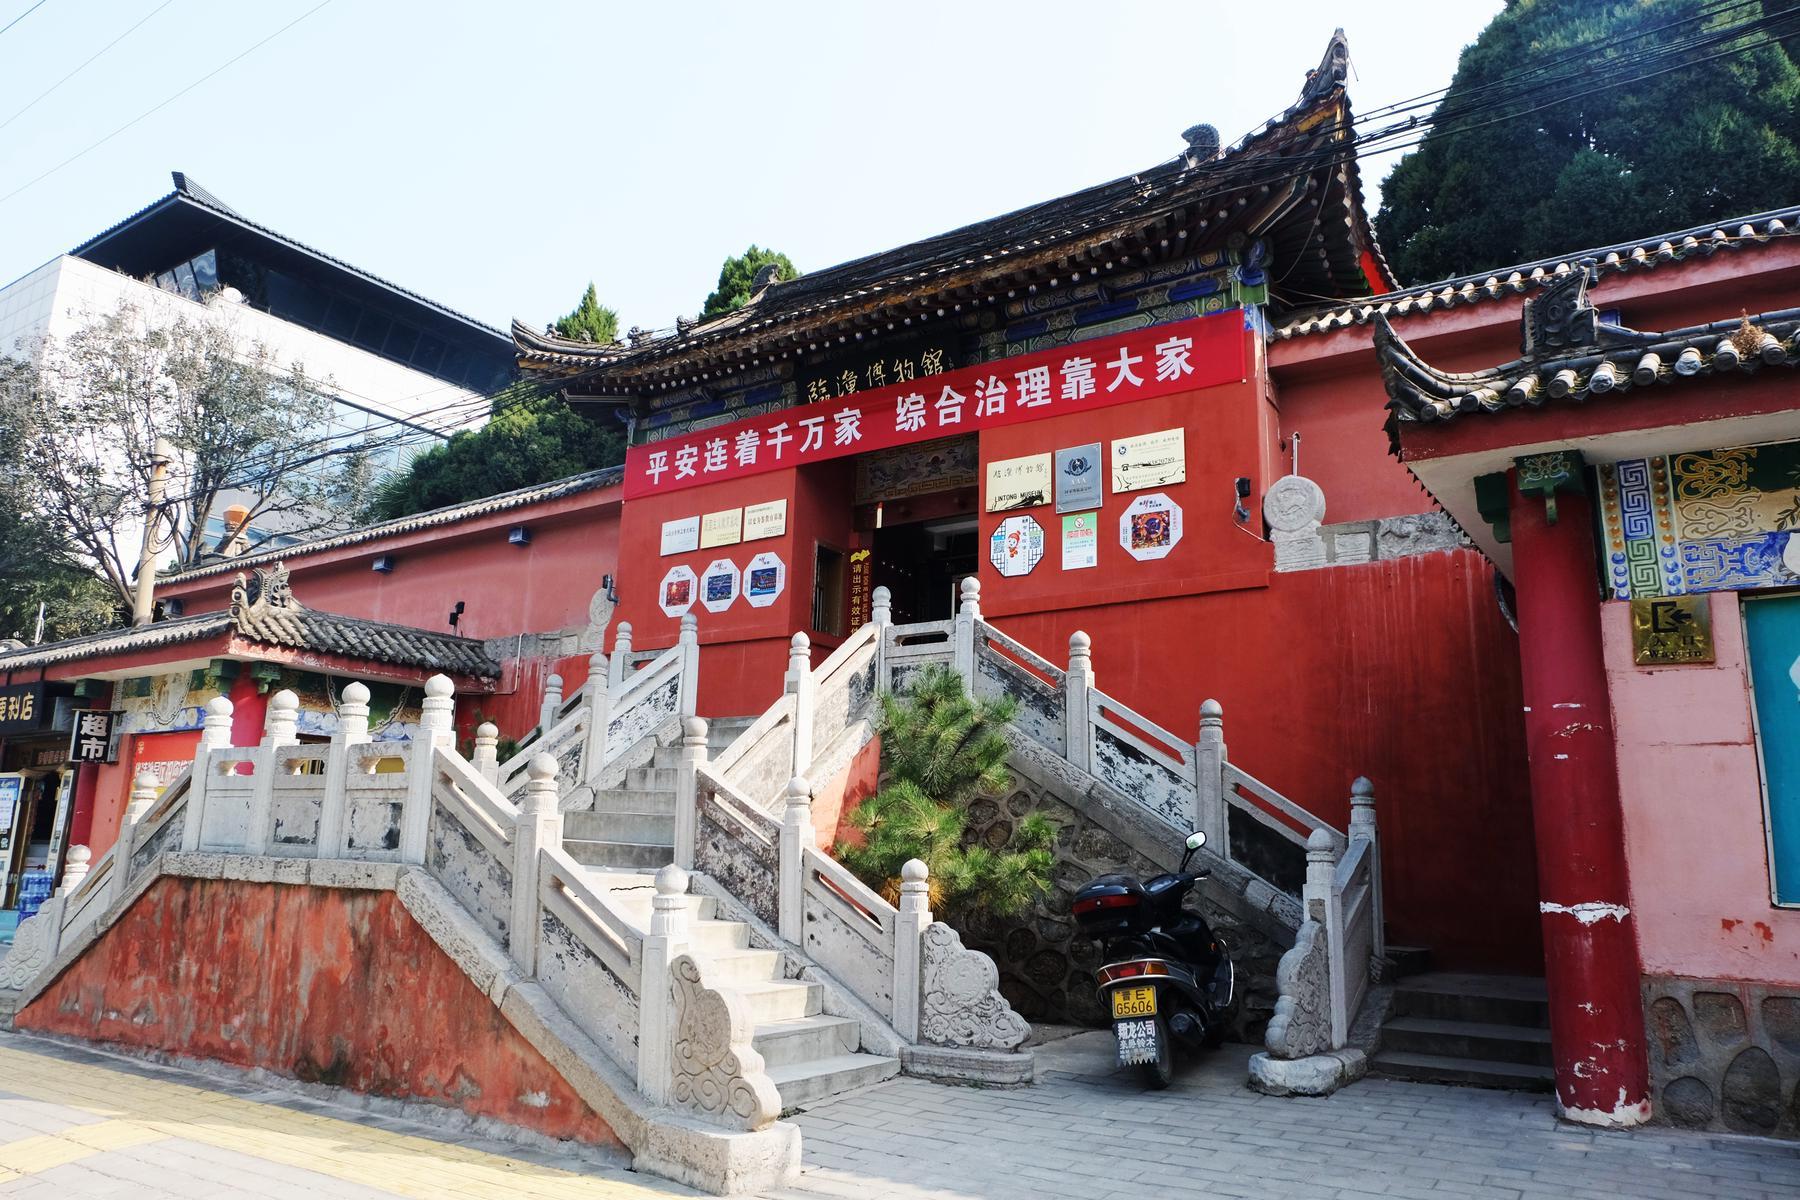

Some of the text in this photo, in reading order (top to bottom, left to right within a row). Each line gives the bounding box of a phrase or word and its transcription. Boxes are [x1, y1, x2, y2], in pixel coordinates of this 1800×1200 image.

[645, 335, 1195, 485] 平安连着千万家 综合治理靠大家
[994, 489, 1043, 503] LINTONG MUSEUM
[1654, 635, 1695, 647] 入口
[80, 714, 108, 759] 超市
[1116, 1001, 1152, 1014] G5606
